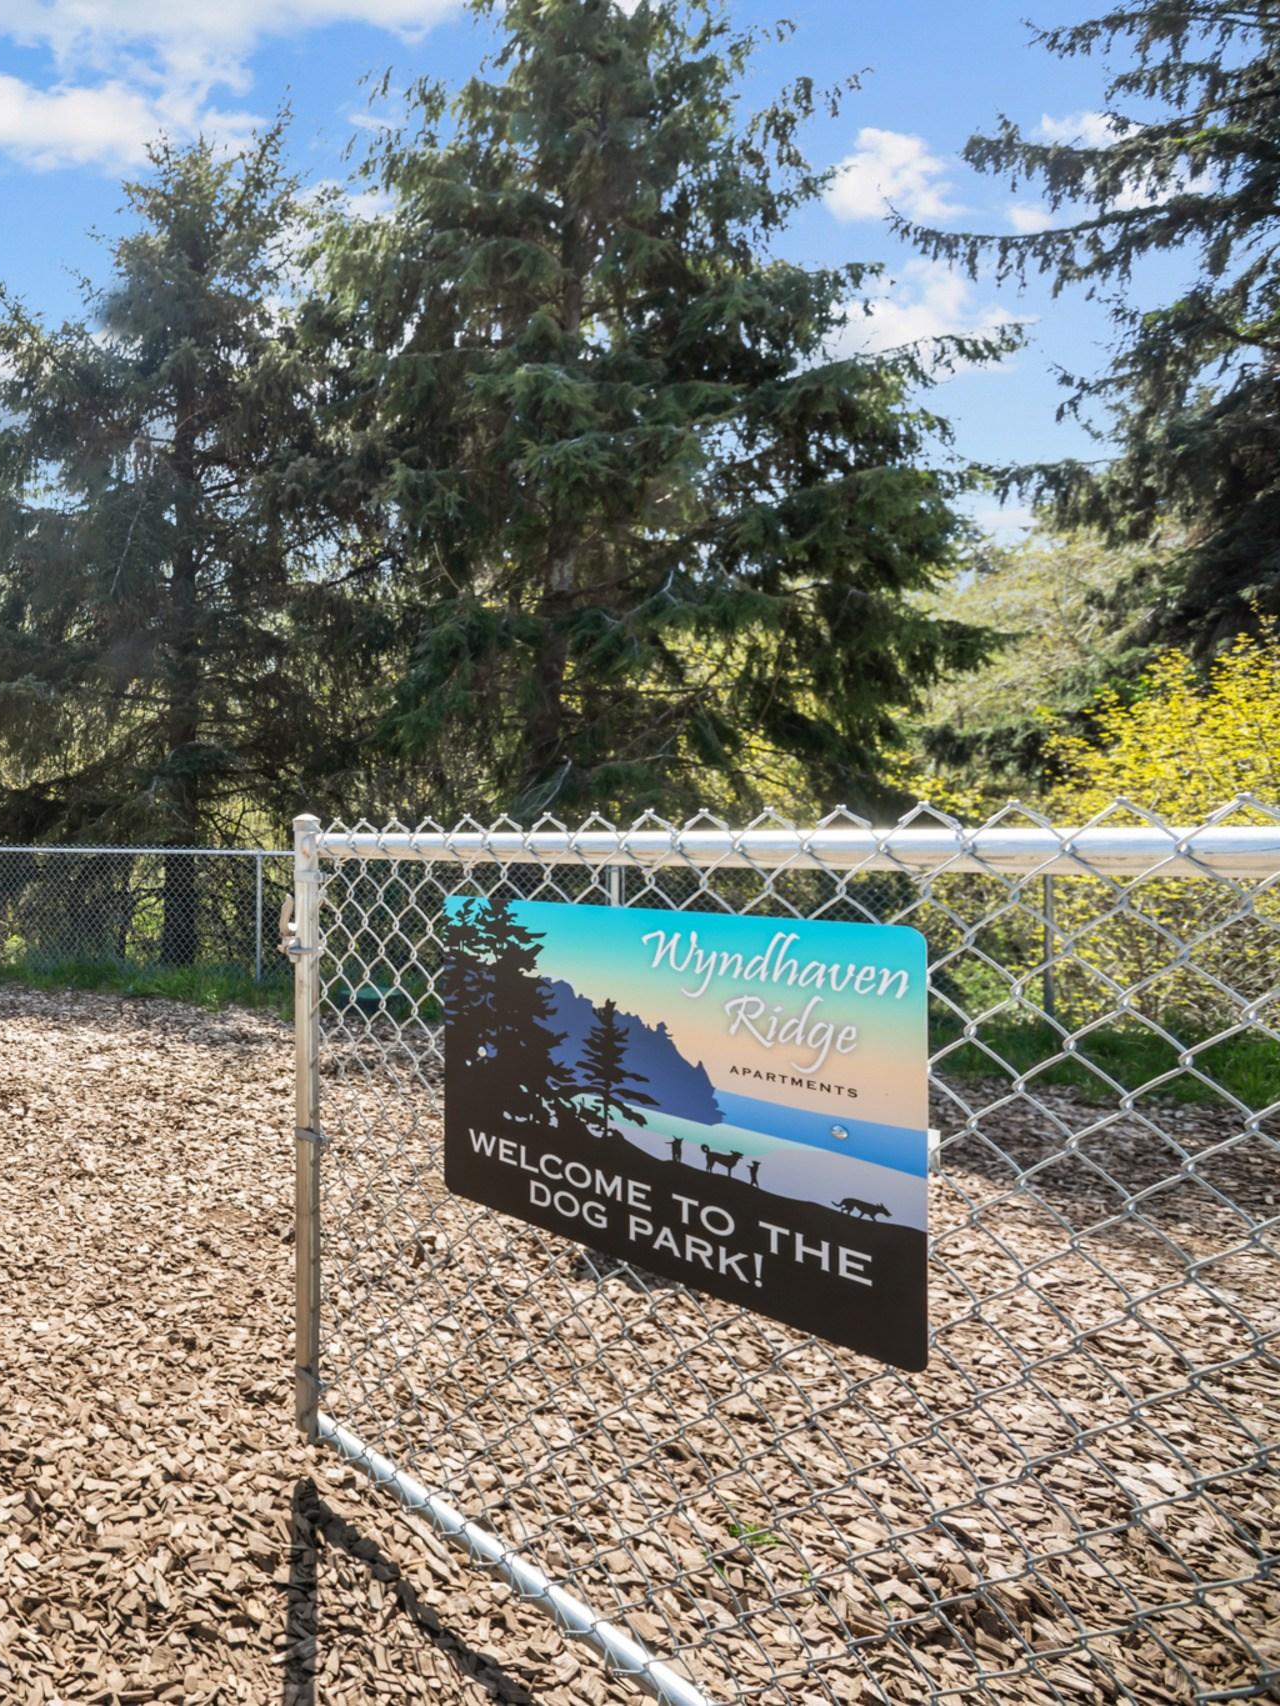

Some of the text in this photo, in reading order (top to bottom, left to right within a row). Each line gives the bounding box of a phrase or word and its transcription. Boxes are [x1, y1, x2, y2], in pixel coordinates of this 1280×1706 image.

[641, 930, 910, 999] Wyndhaven
[724, 995, 857, 1074] Ridge
[729, 1065, 858, 1098] APARTMENTS
[468, 1128, 873, 1287] WELCOME TO THE
[529, 1179, 764, 1289] DOG PARK!
